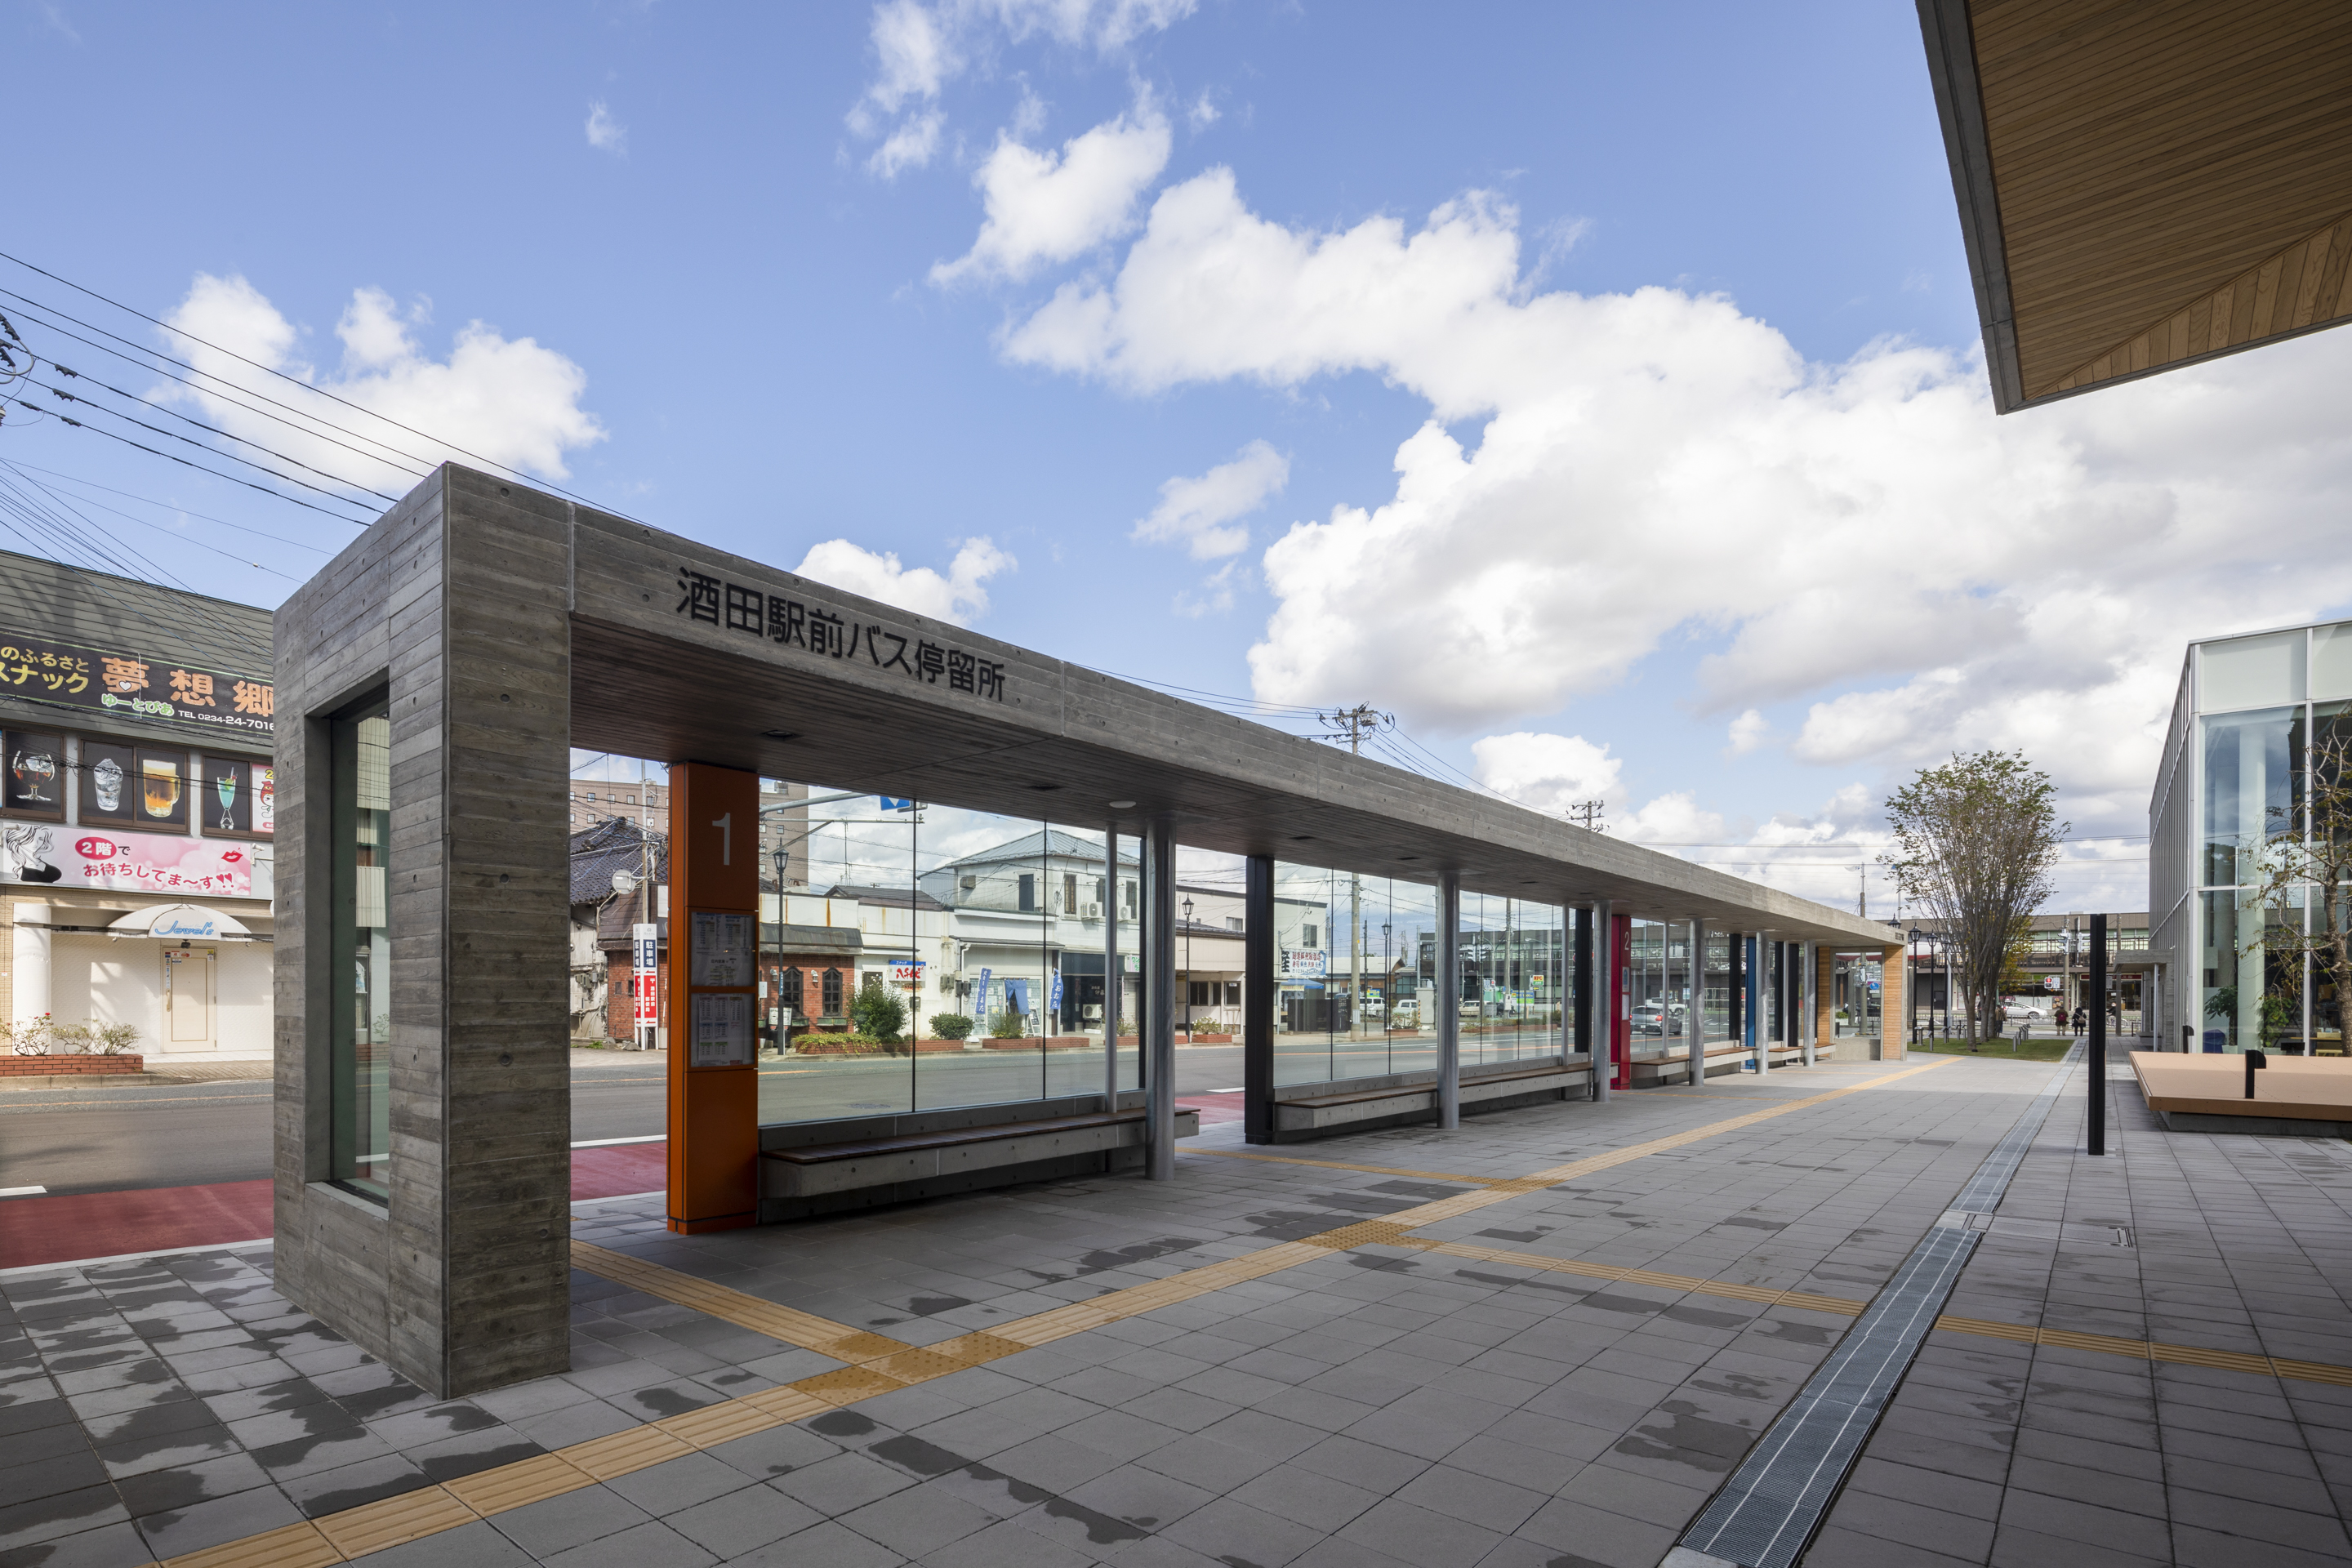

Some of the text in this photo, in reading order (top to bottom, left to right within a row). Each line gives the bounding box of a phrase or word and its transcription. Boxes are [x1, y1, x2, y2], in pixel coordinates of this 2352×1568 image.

[676, 567, 1005, 702] 酒田駅前バス停留所
[1, 646, 89, 673] のふるさと
[101, 693, 175, 716] ゆーとぴあ
[178, 710, 196, 719] TEL
[712, 813, 730, 865] 1
[154, 920, 214, 935] Jewel's
[1624, 931, 1629, 951] 2
[645, 941, 653, 966] 駐車場
